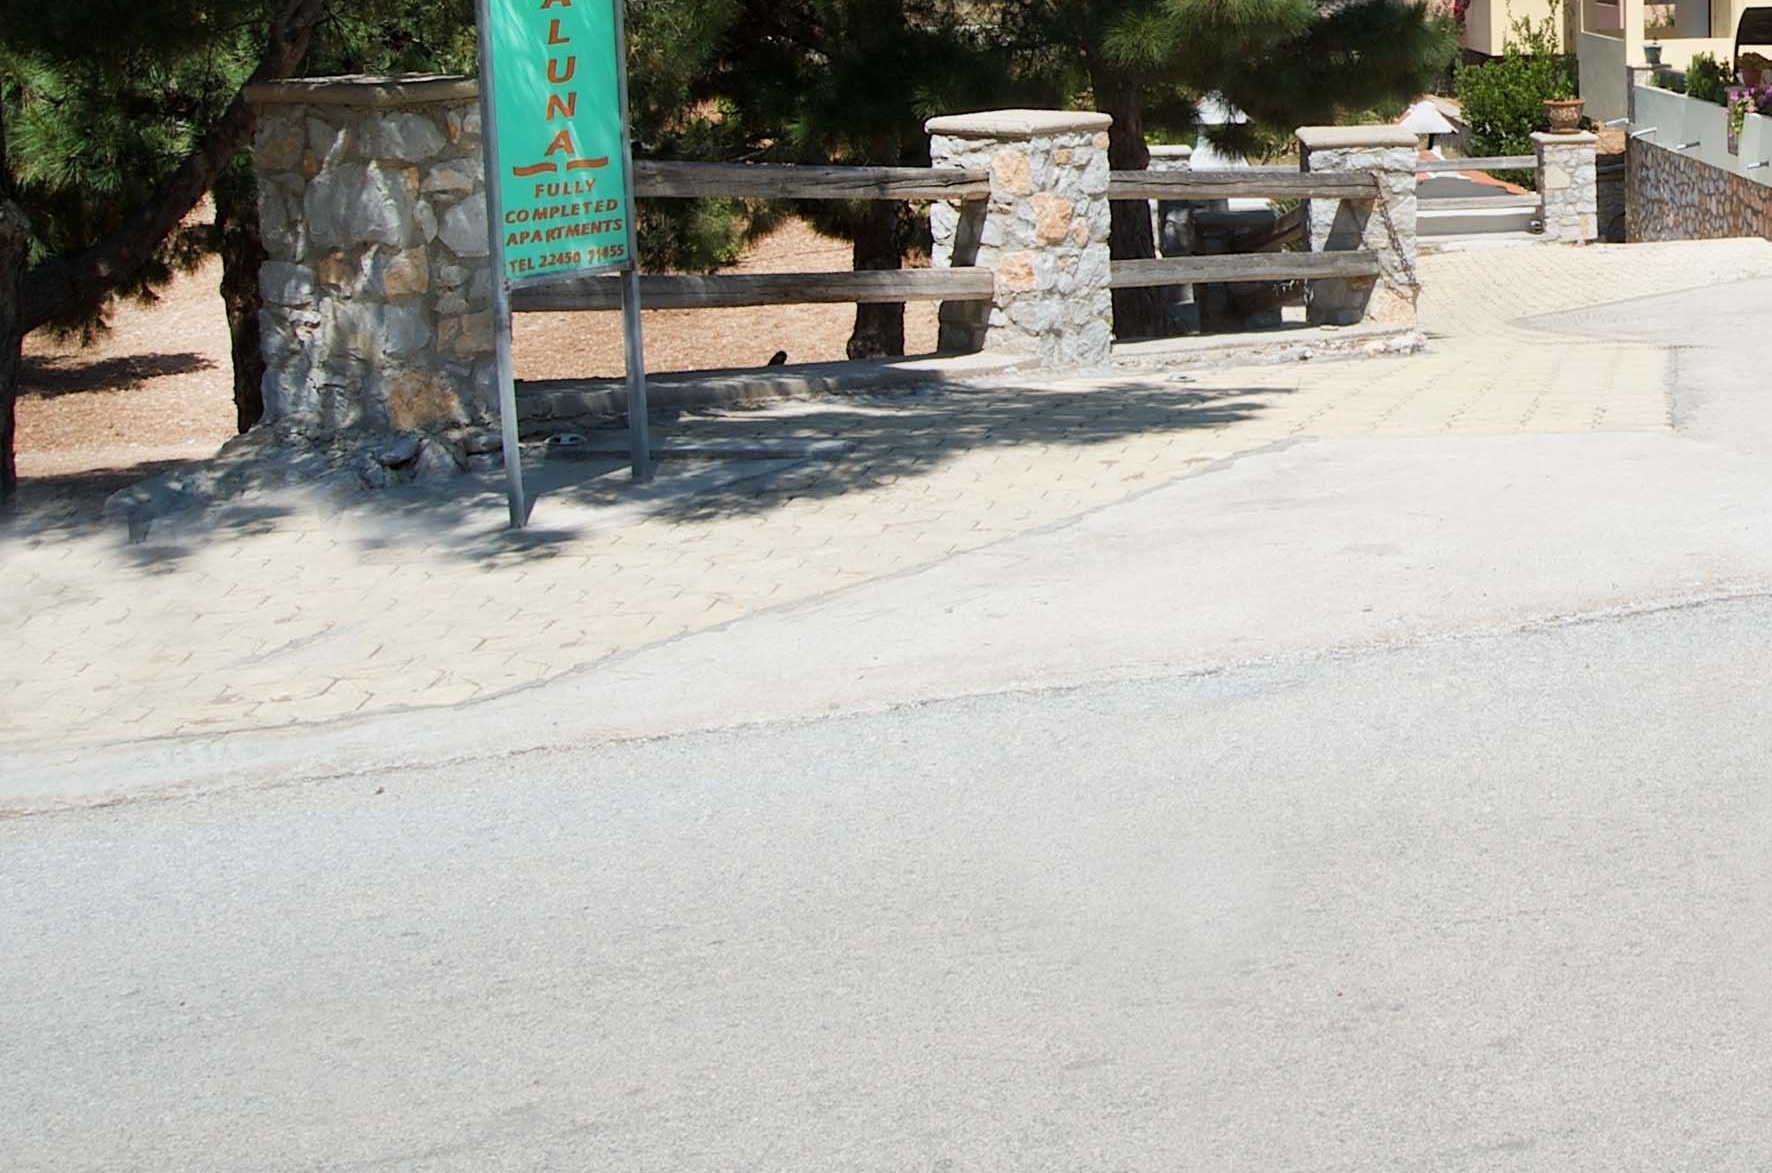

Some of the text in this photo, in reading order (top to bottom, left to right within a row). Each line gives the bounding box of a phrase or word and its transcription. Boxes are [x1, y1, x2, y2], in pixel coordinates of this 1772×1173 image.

[534, 178, 596, 199] FULLY
[504, 199, 618, 224] COMPLETED
[506, 219, 622, 246] APARTMENTS
[509, 258, 535, 274] TEL
